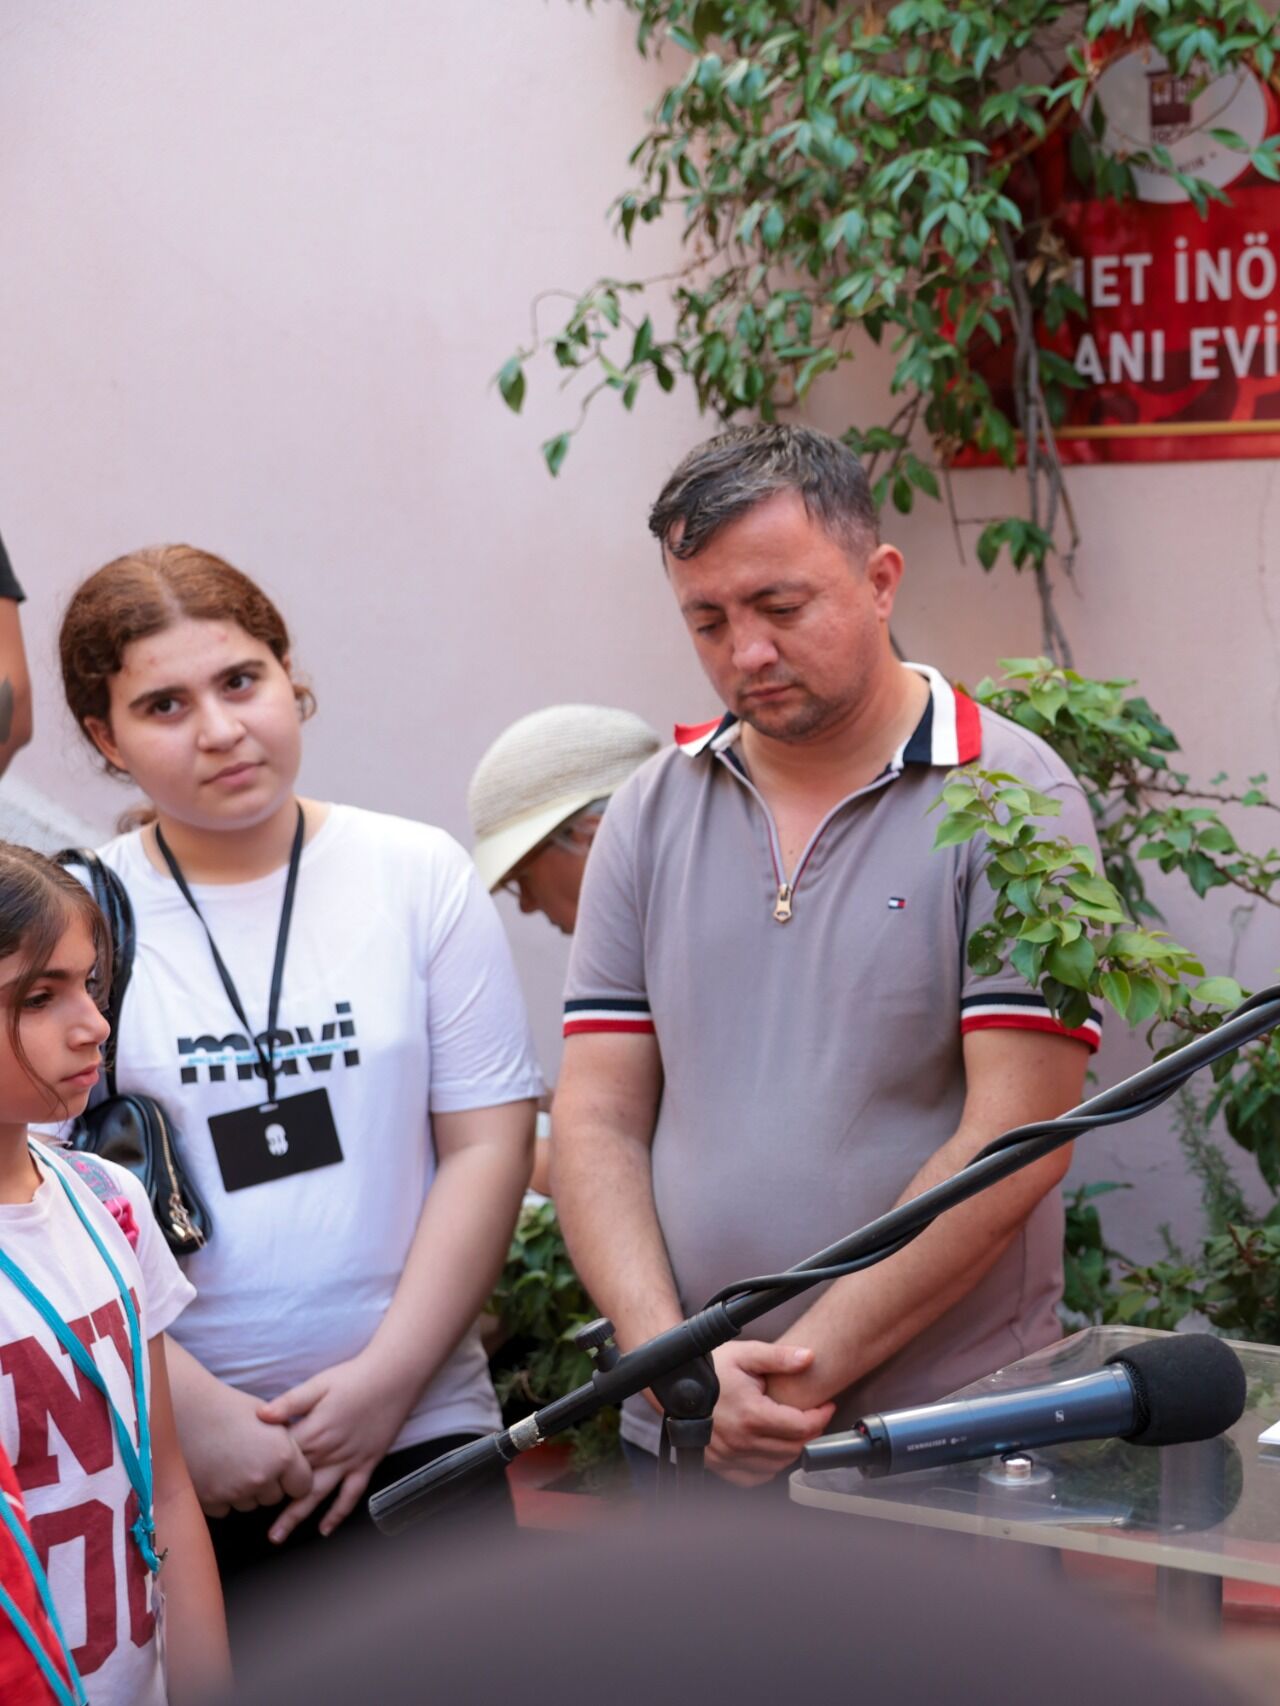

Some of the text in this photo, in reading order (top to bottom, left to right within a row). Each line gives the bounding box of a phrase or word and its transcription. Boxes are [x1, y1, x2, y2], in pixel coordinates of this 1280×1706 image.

[1072, 309, 1279, 385] ANI EVİ
[177, 1002, 360, 1084] mavi
